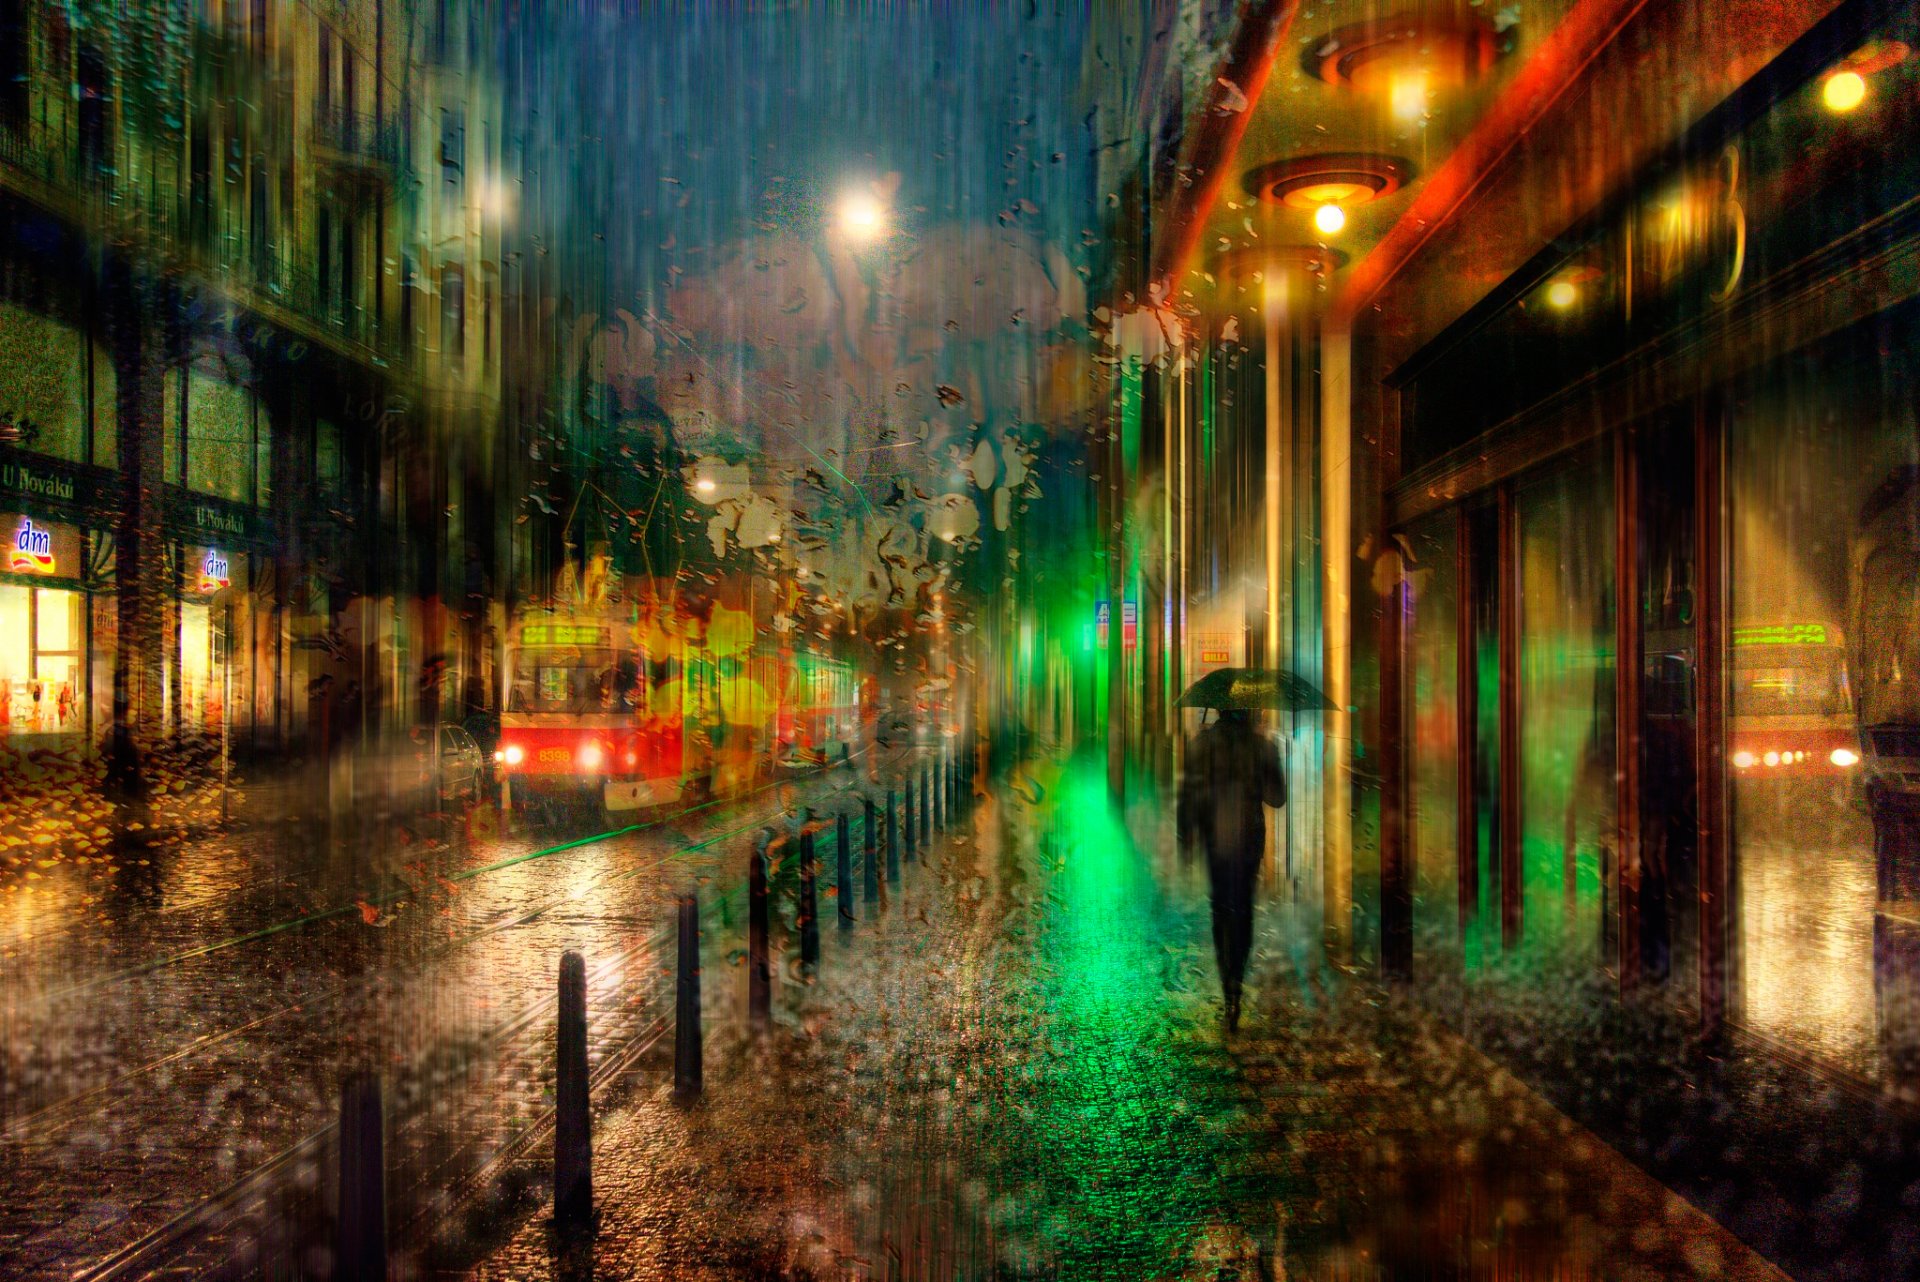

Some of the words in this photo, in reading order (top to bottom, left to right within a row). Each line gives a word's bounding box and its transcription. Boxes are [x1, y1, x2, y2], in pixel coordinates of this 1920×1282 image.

[3, 464, 14, 487] U
[19, 467, 75, 500] Nováků
[196, 506, 206, 526] U
[18, 520, 50, 555] dm
[205, 551, 228, 579] dm
[539, 750, 570, 762] 8398
